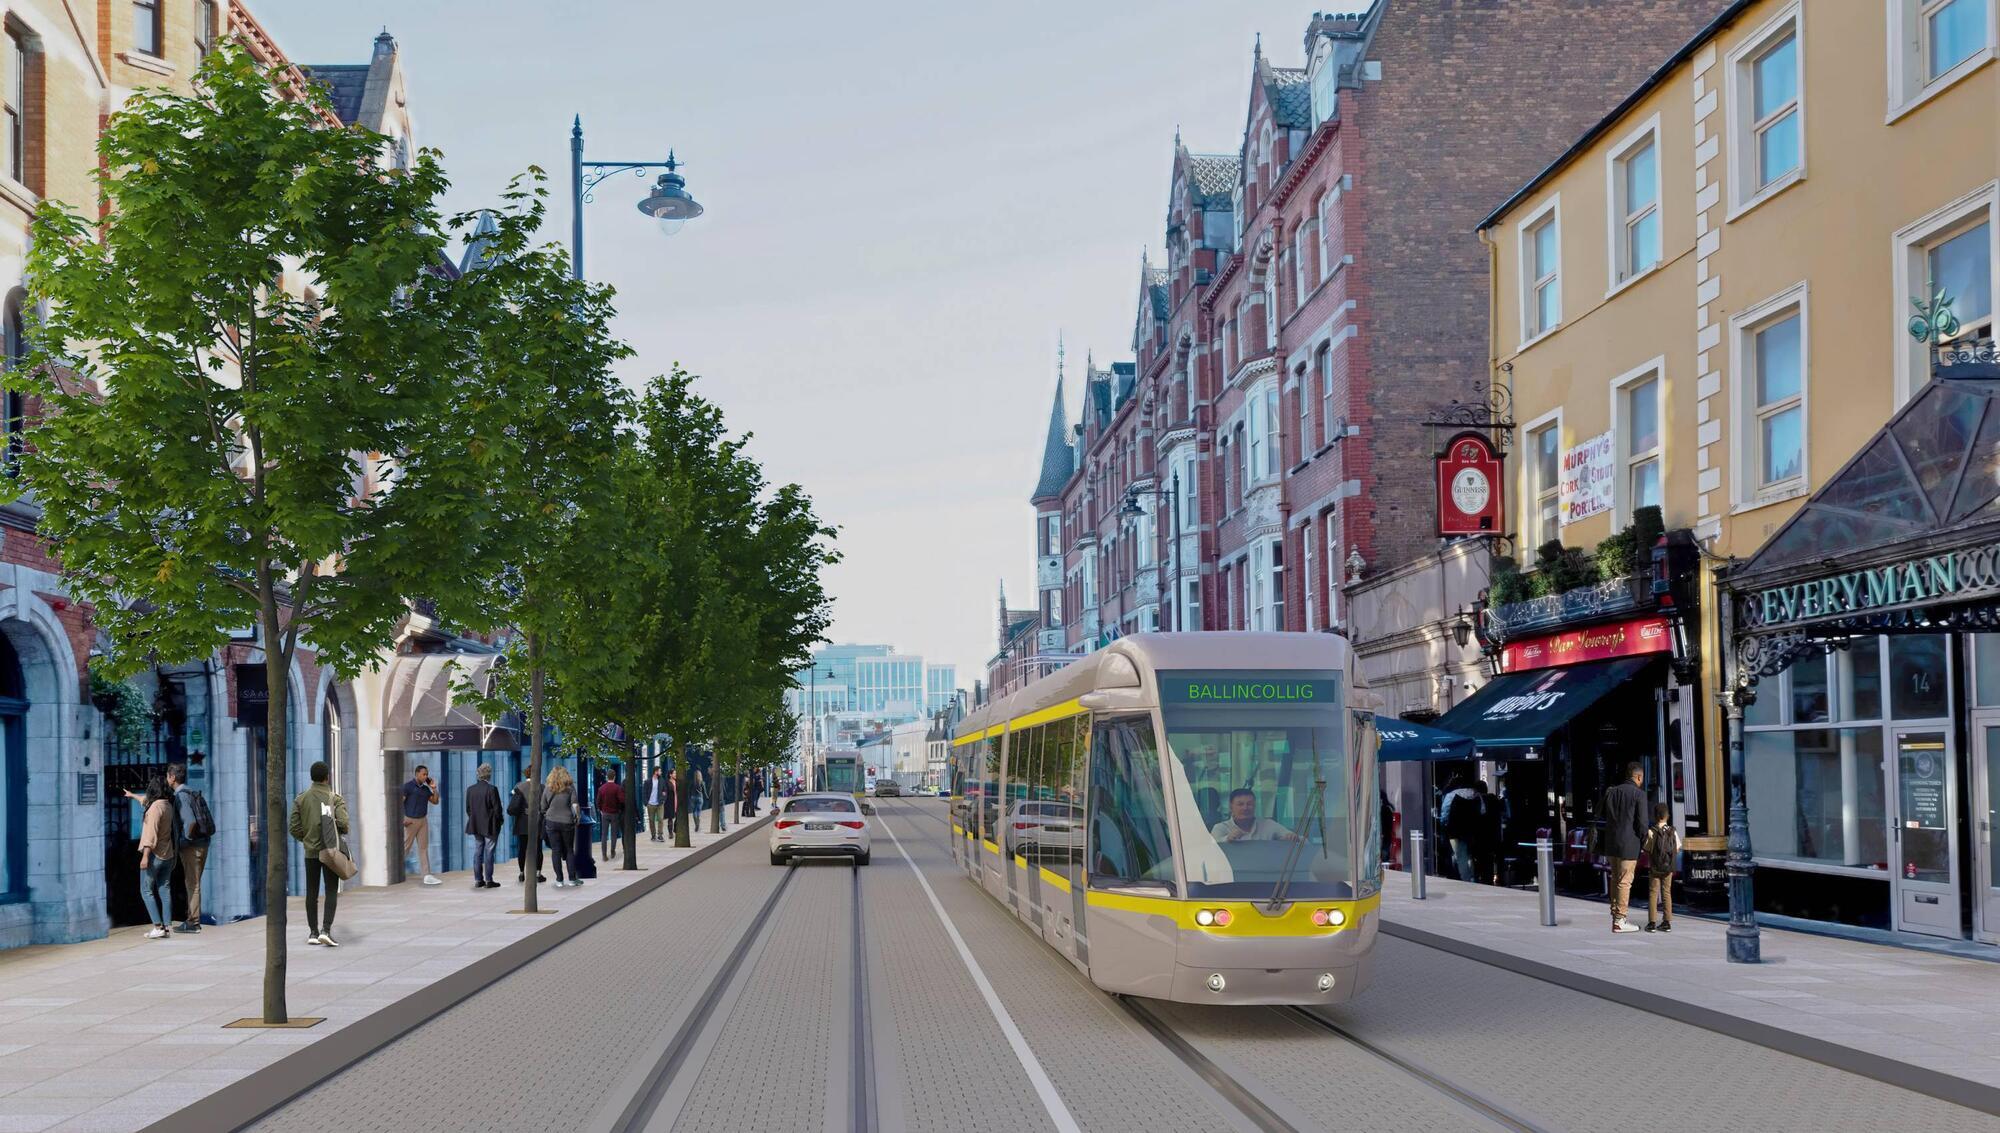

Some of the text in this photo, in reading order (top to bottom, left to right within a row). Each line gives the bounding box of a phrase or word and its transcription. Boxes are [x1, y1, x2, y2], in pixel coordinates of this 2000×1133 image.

[1455, 485, 1487, 494] GUINNESS
[1560, 478, 1580, 497] CORK
[1591, 463, 1613, 484] STOUT
[1762, 552, 1957, 625] EVERYMAN
[1548, 635, 1574, 655] Dan
[1188, 684, 1314, 700] BALLINCOLLIG
[1911, 672, 1930, 693] 14
[411, 731, 455, 741] ISAACS
